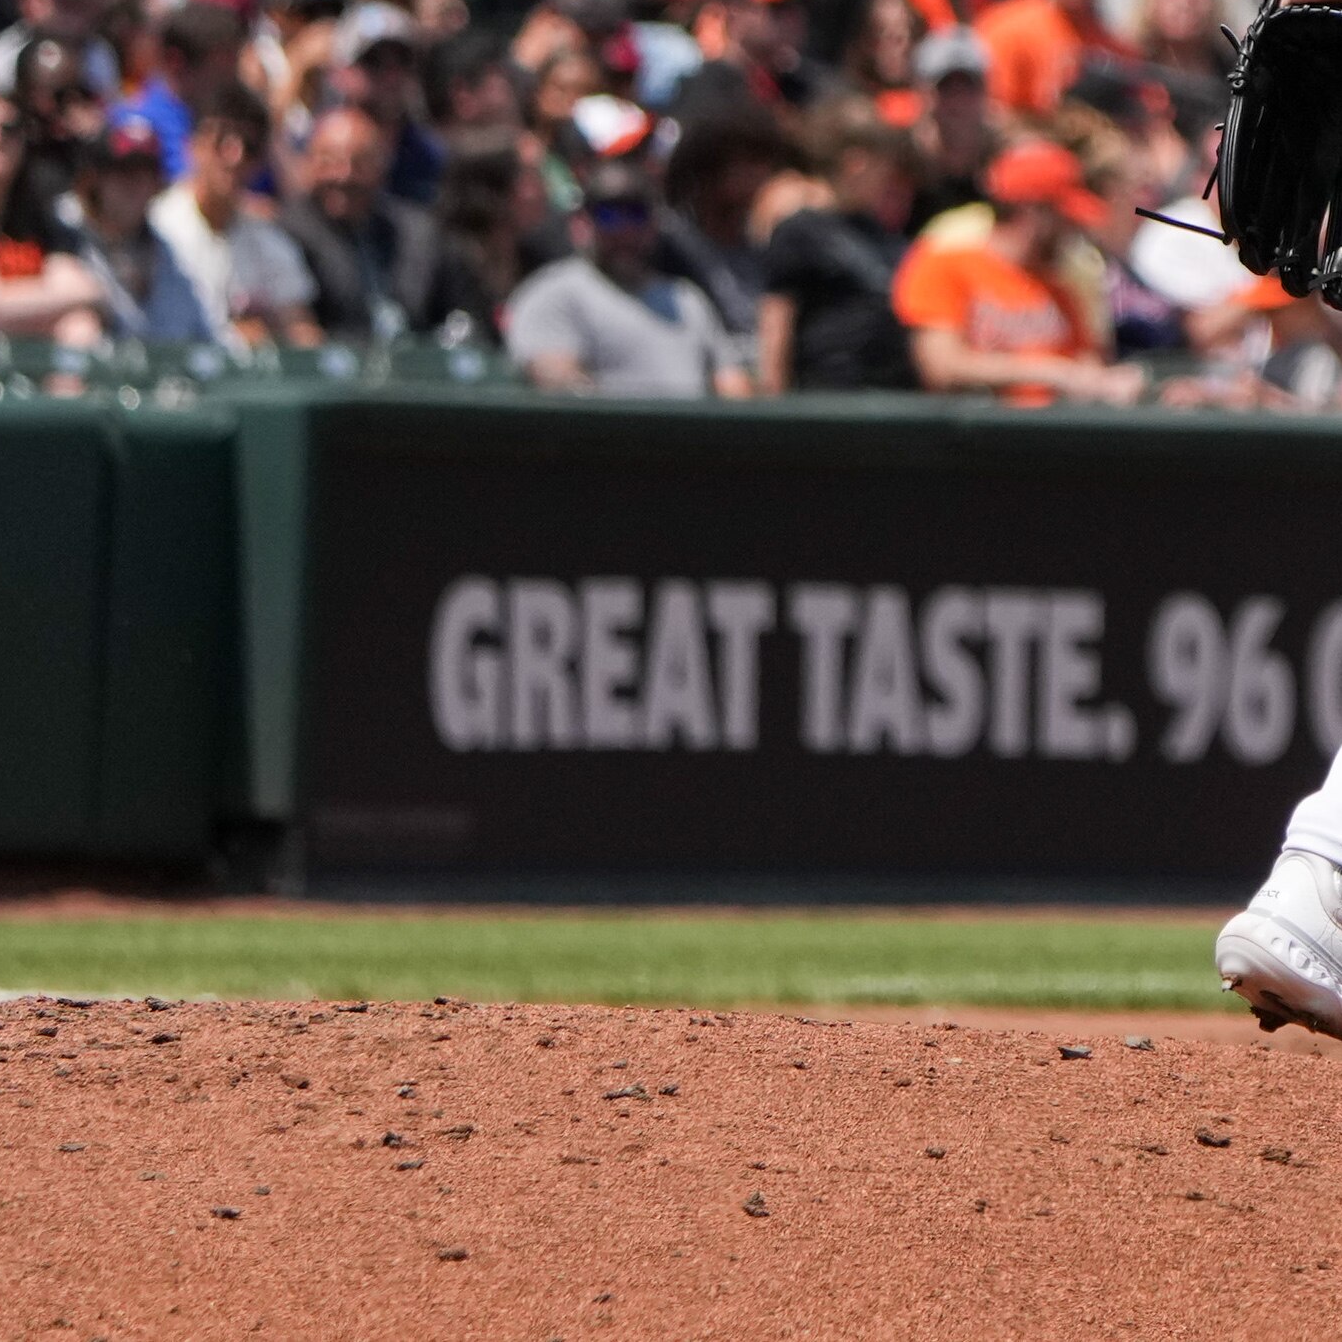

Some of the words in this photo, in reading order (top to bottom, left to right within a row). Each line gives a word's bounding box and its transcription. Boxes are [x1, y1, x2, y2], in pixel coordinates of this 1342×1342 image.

[430, 573, 778, 754] GREAT
[785, 580, 1138, 762] TASTE.
[1148, 590, 1298, 765] 96
